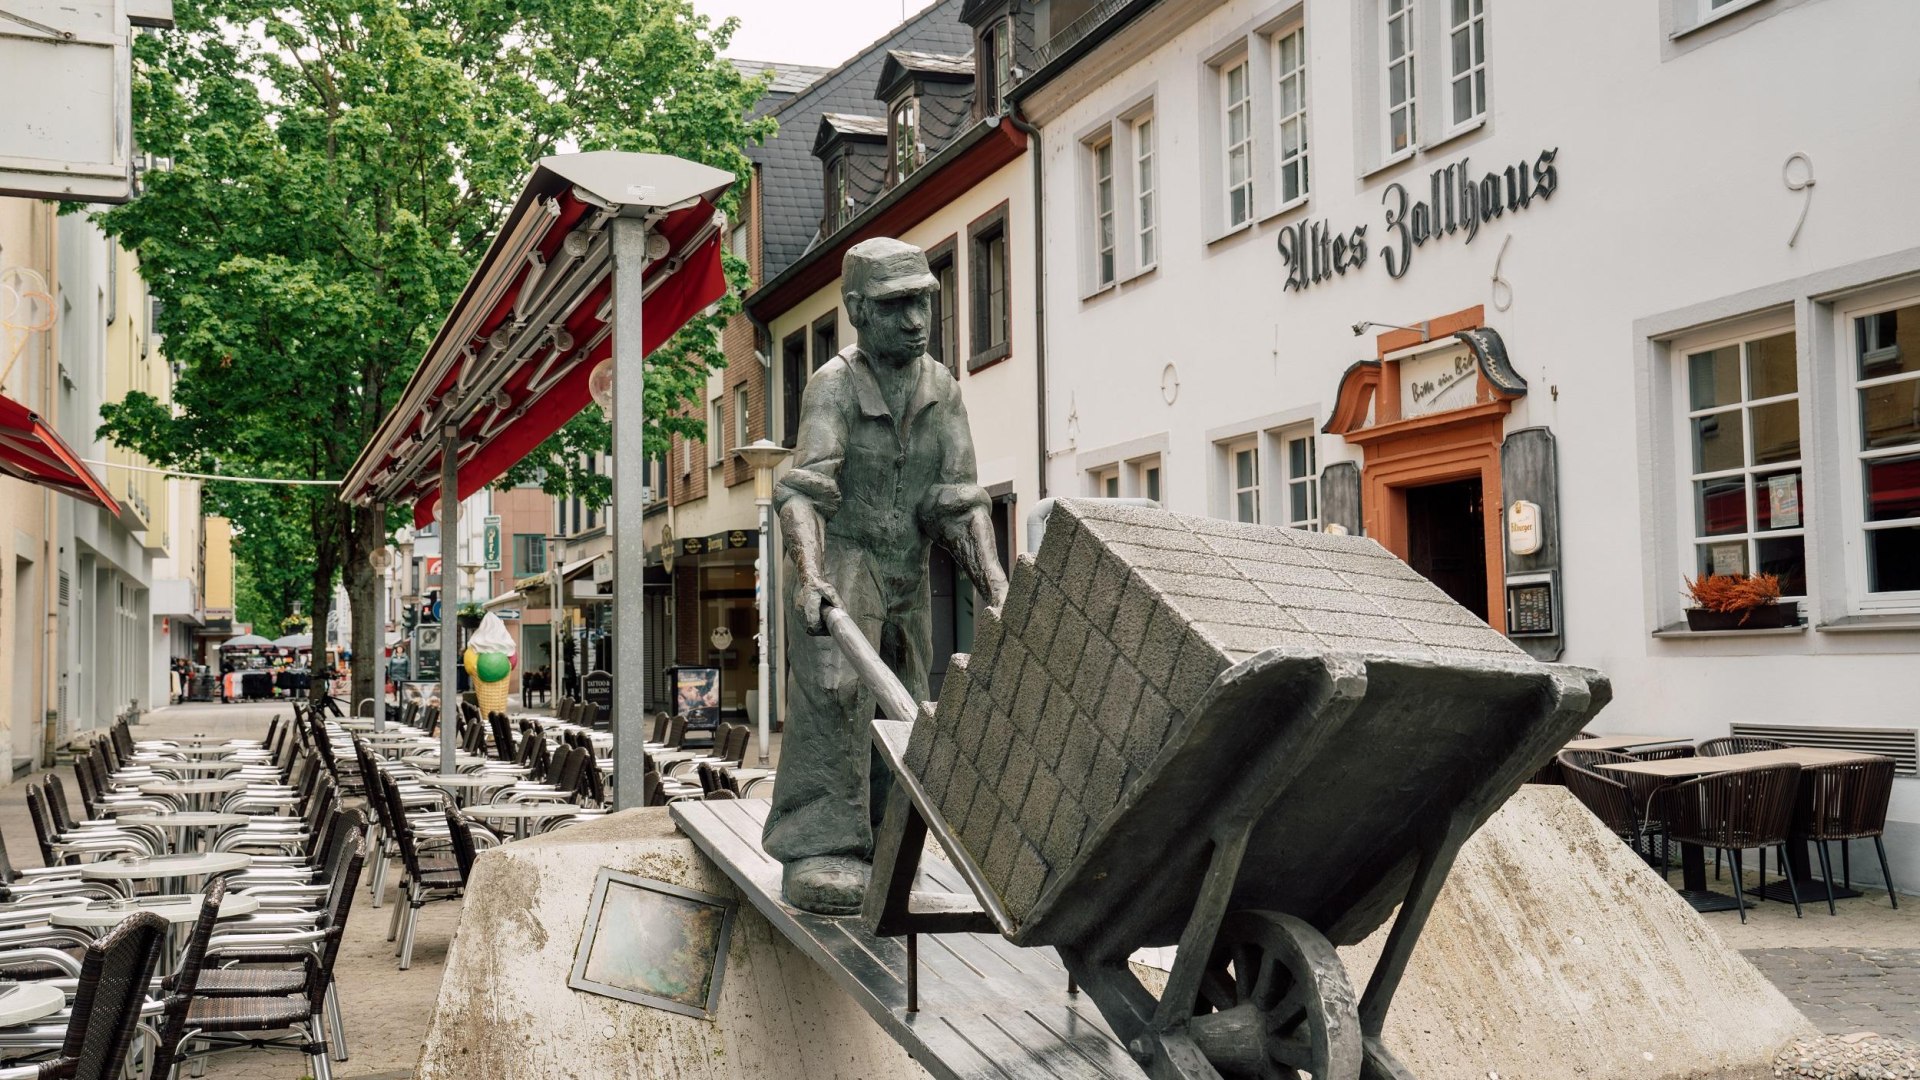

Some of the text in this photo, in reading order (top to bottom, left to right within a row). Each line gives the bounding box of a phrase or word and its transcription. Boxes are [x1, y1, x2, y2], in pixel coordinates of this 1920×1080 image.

[1277, 146, 1559, 292] Altes Zollhaus
[1411, 352, 1476, 403] Bitte ein Bit
[1550, 384, 1559, 402] 4
